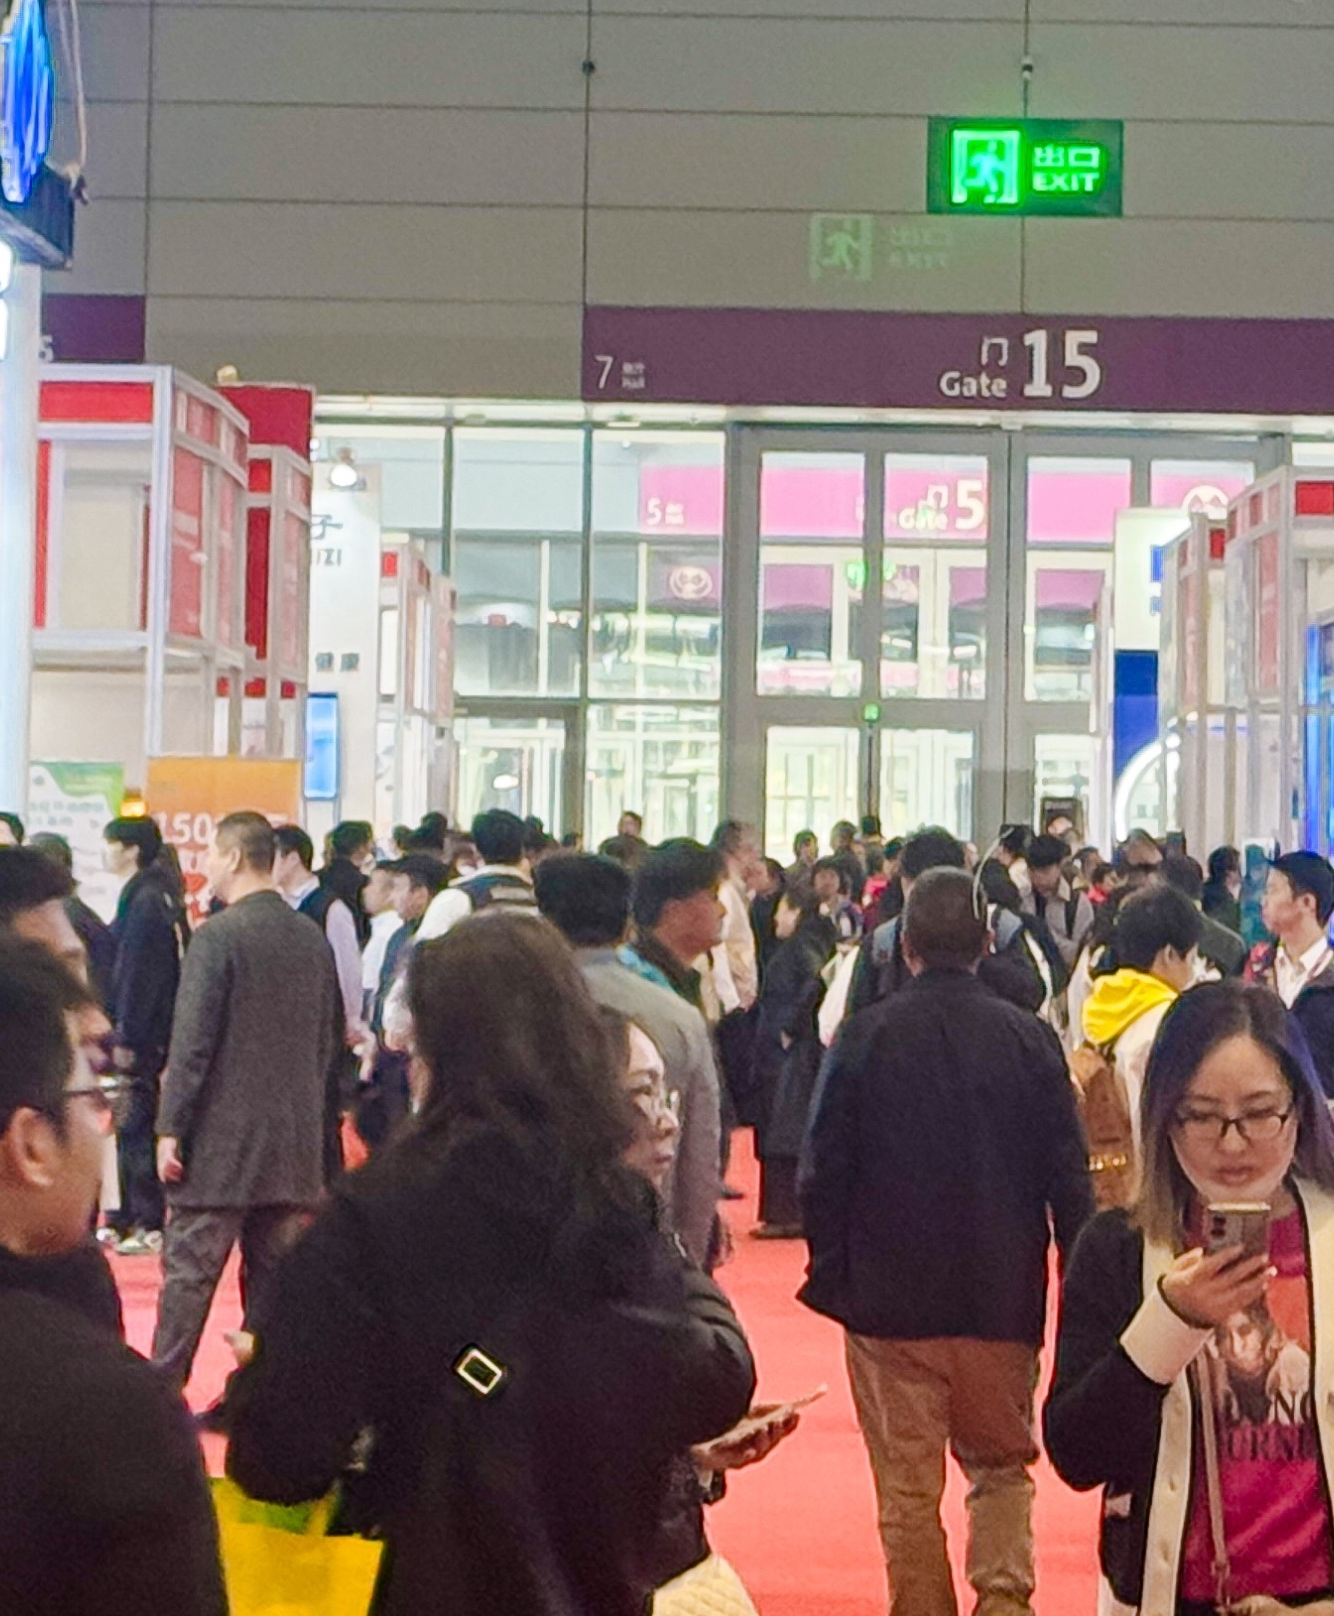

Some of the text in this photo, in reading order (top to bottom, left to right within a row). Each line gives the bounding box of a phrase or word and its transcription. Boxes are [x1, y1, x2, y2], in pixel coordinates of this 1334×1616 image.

[1033, 145, 1101, 168] 出口
[1032, 173, 1100, 191] EXIT
[939, 330, 1102, 399] Gate 15
[980, 336, 1009, 366] 门
[593, 355, 615, 389] 7
[647, 498, 663, 526] 5
